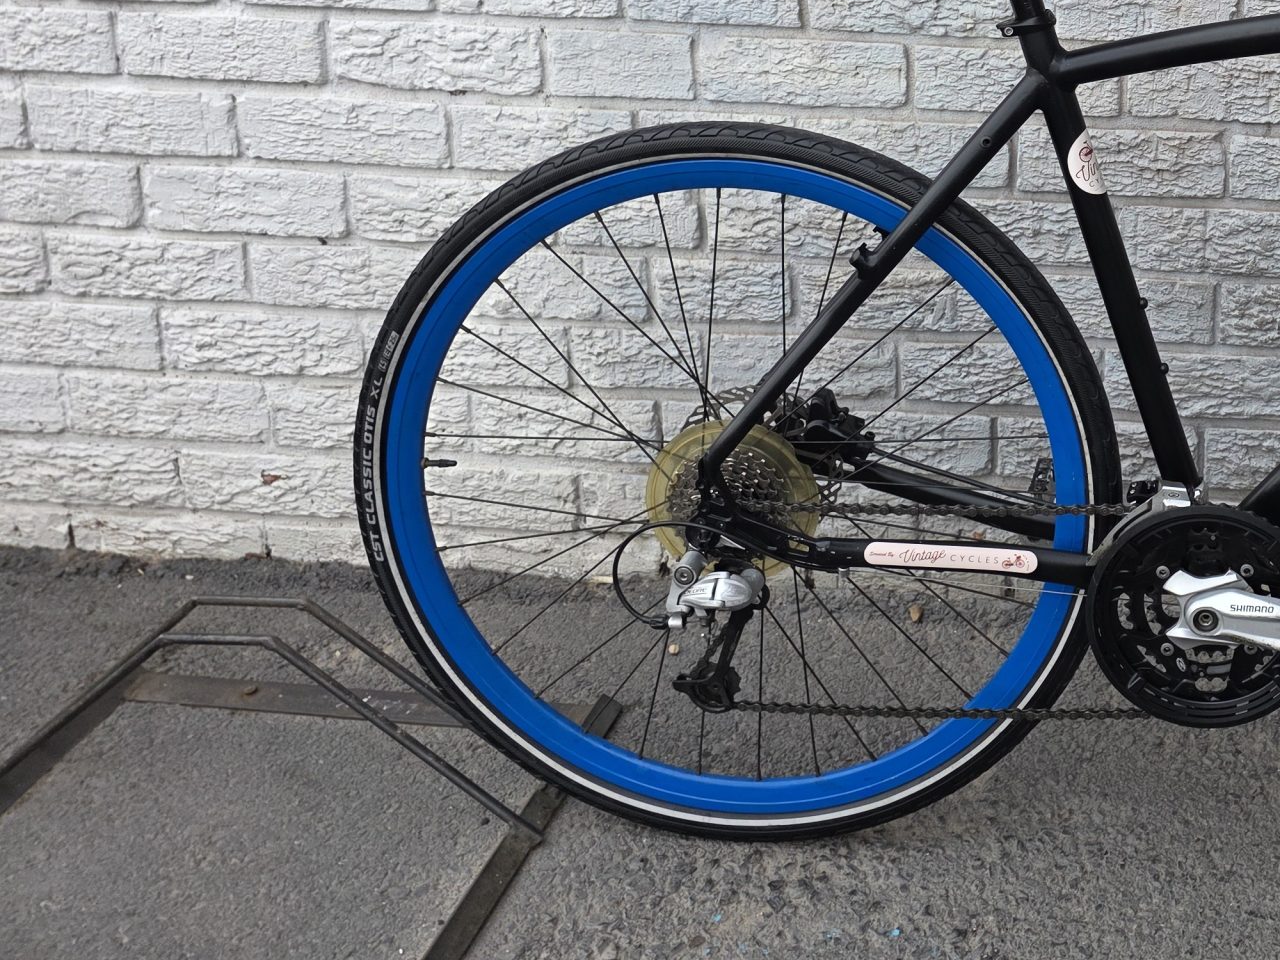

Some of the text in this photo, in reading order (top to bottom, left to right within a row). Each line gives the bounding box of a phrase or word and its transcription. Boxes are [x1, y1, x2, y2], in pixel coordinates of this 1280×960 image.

[370, 376, 383, 400] XL
[363, 404, 376, 444] OTIS
[362, 447, 376, 525] CLASSIC
[369, 530, 385, 562] CST
[899, 548, 947, 564] Vintage
[950, 554, 999, 564] CYCLES
[1230, 604, 1275, 613] SHIMANO
